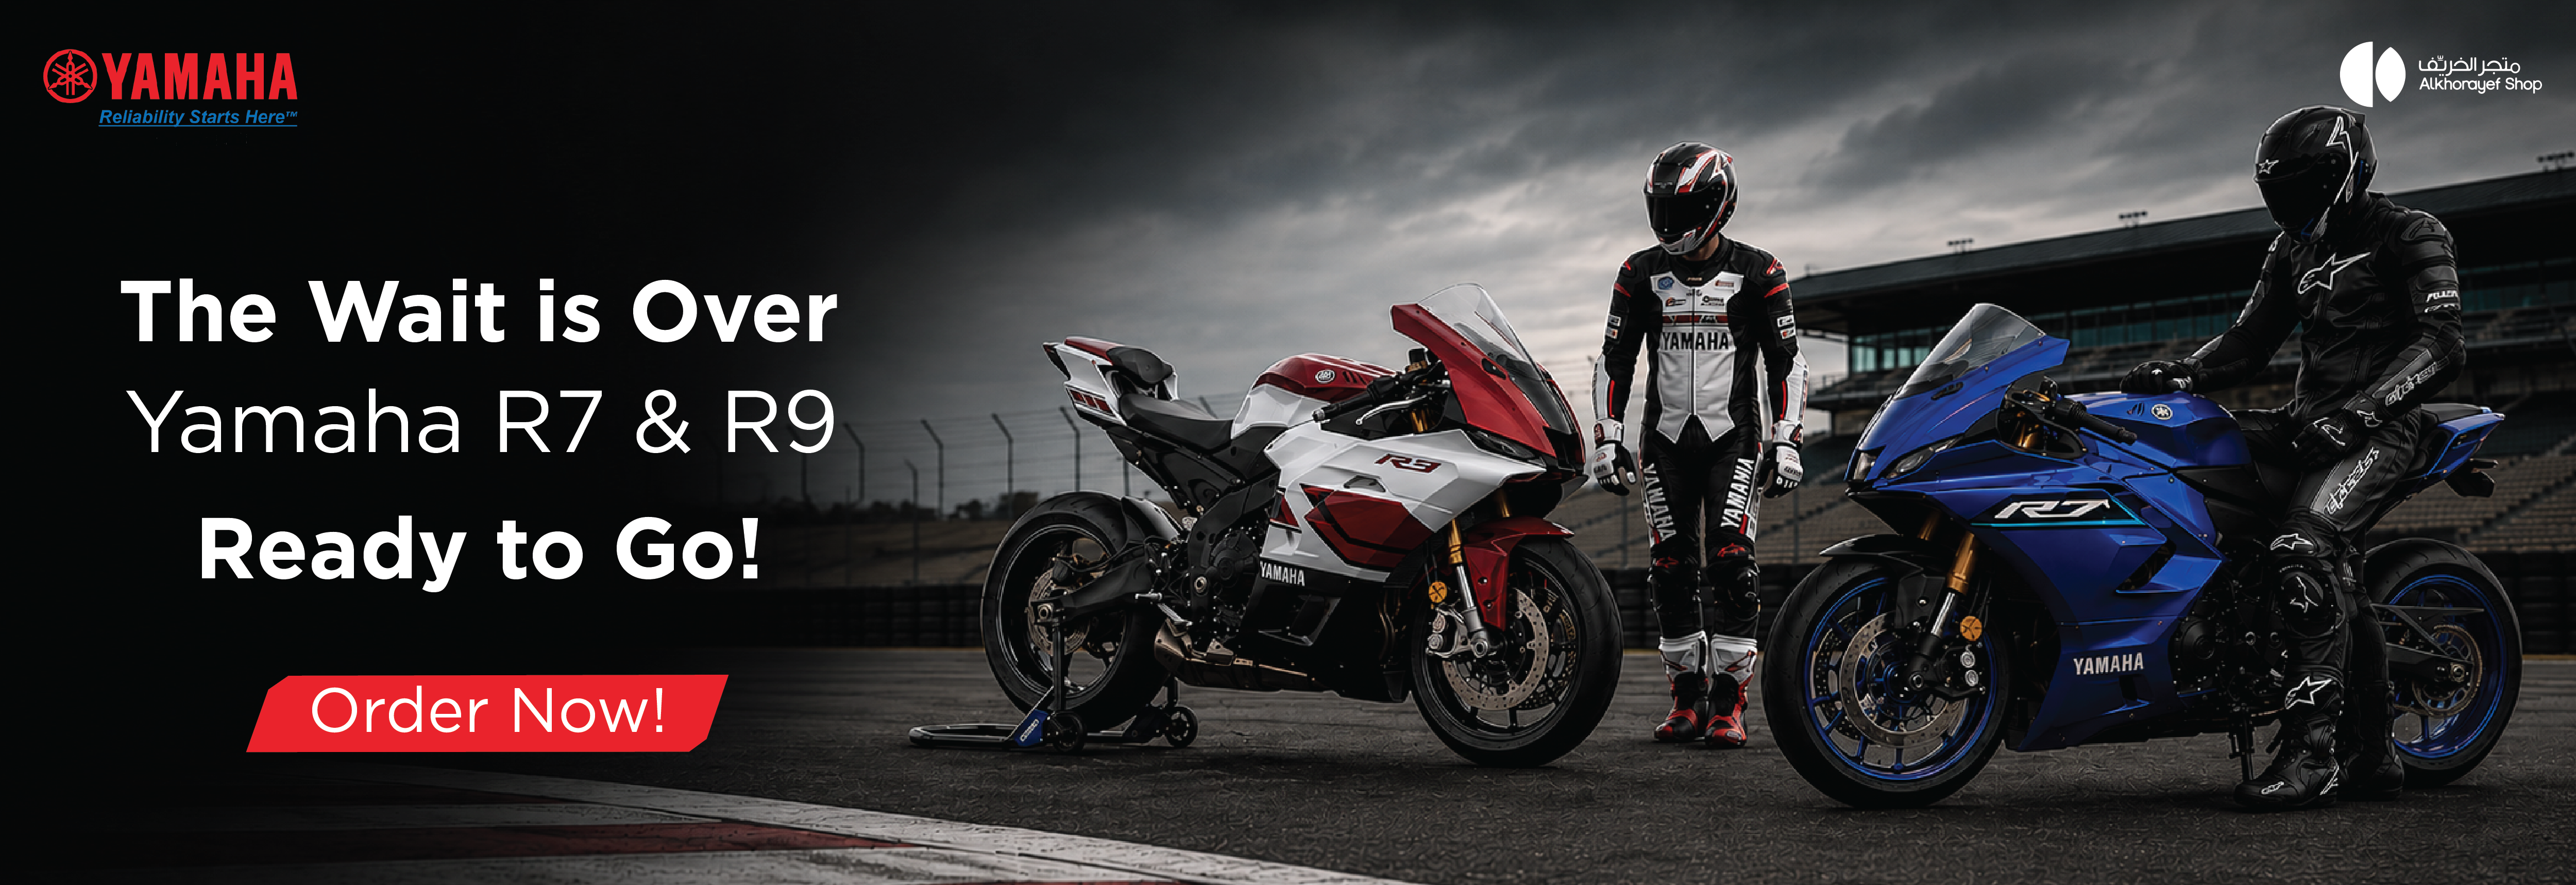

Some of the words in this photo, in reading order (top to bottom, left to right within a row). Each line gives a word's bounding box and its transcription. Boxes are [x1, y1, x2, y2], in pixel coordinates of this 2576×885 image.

[1662, 331, 1729, 351] YAMAHA
[1994, 498, 2111, 519] R7
[1260, 560, 1305, 587] YAMAHA
[2073, 652, 2145, 675] YAMAHA
